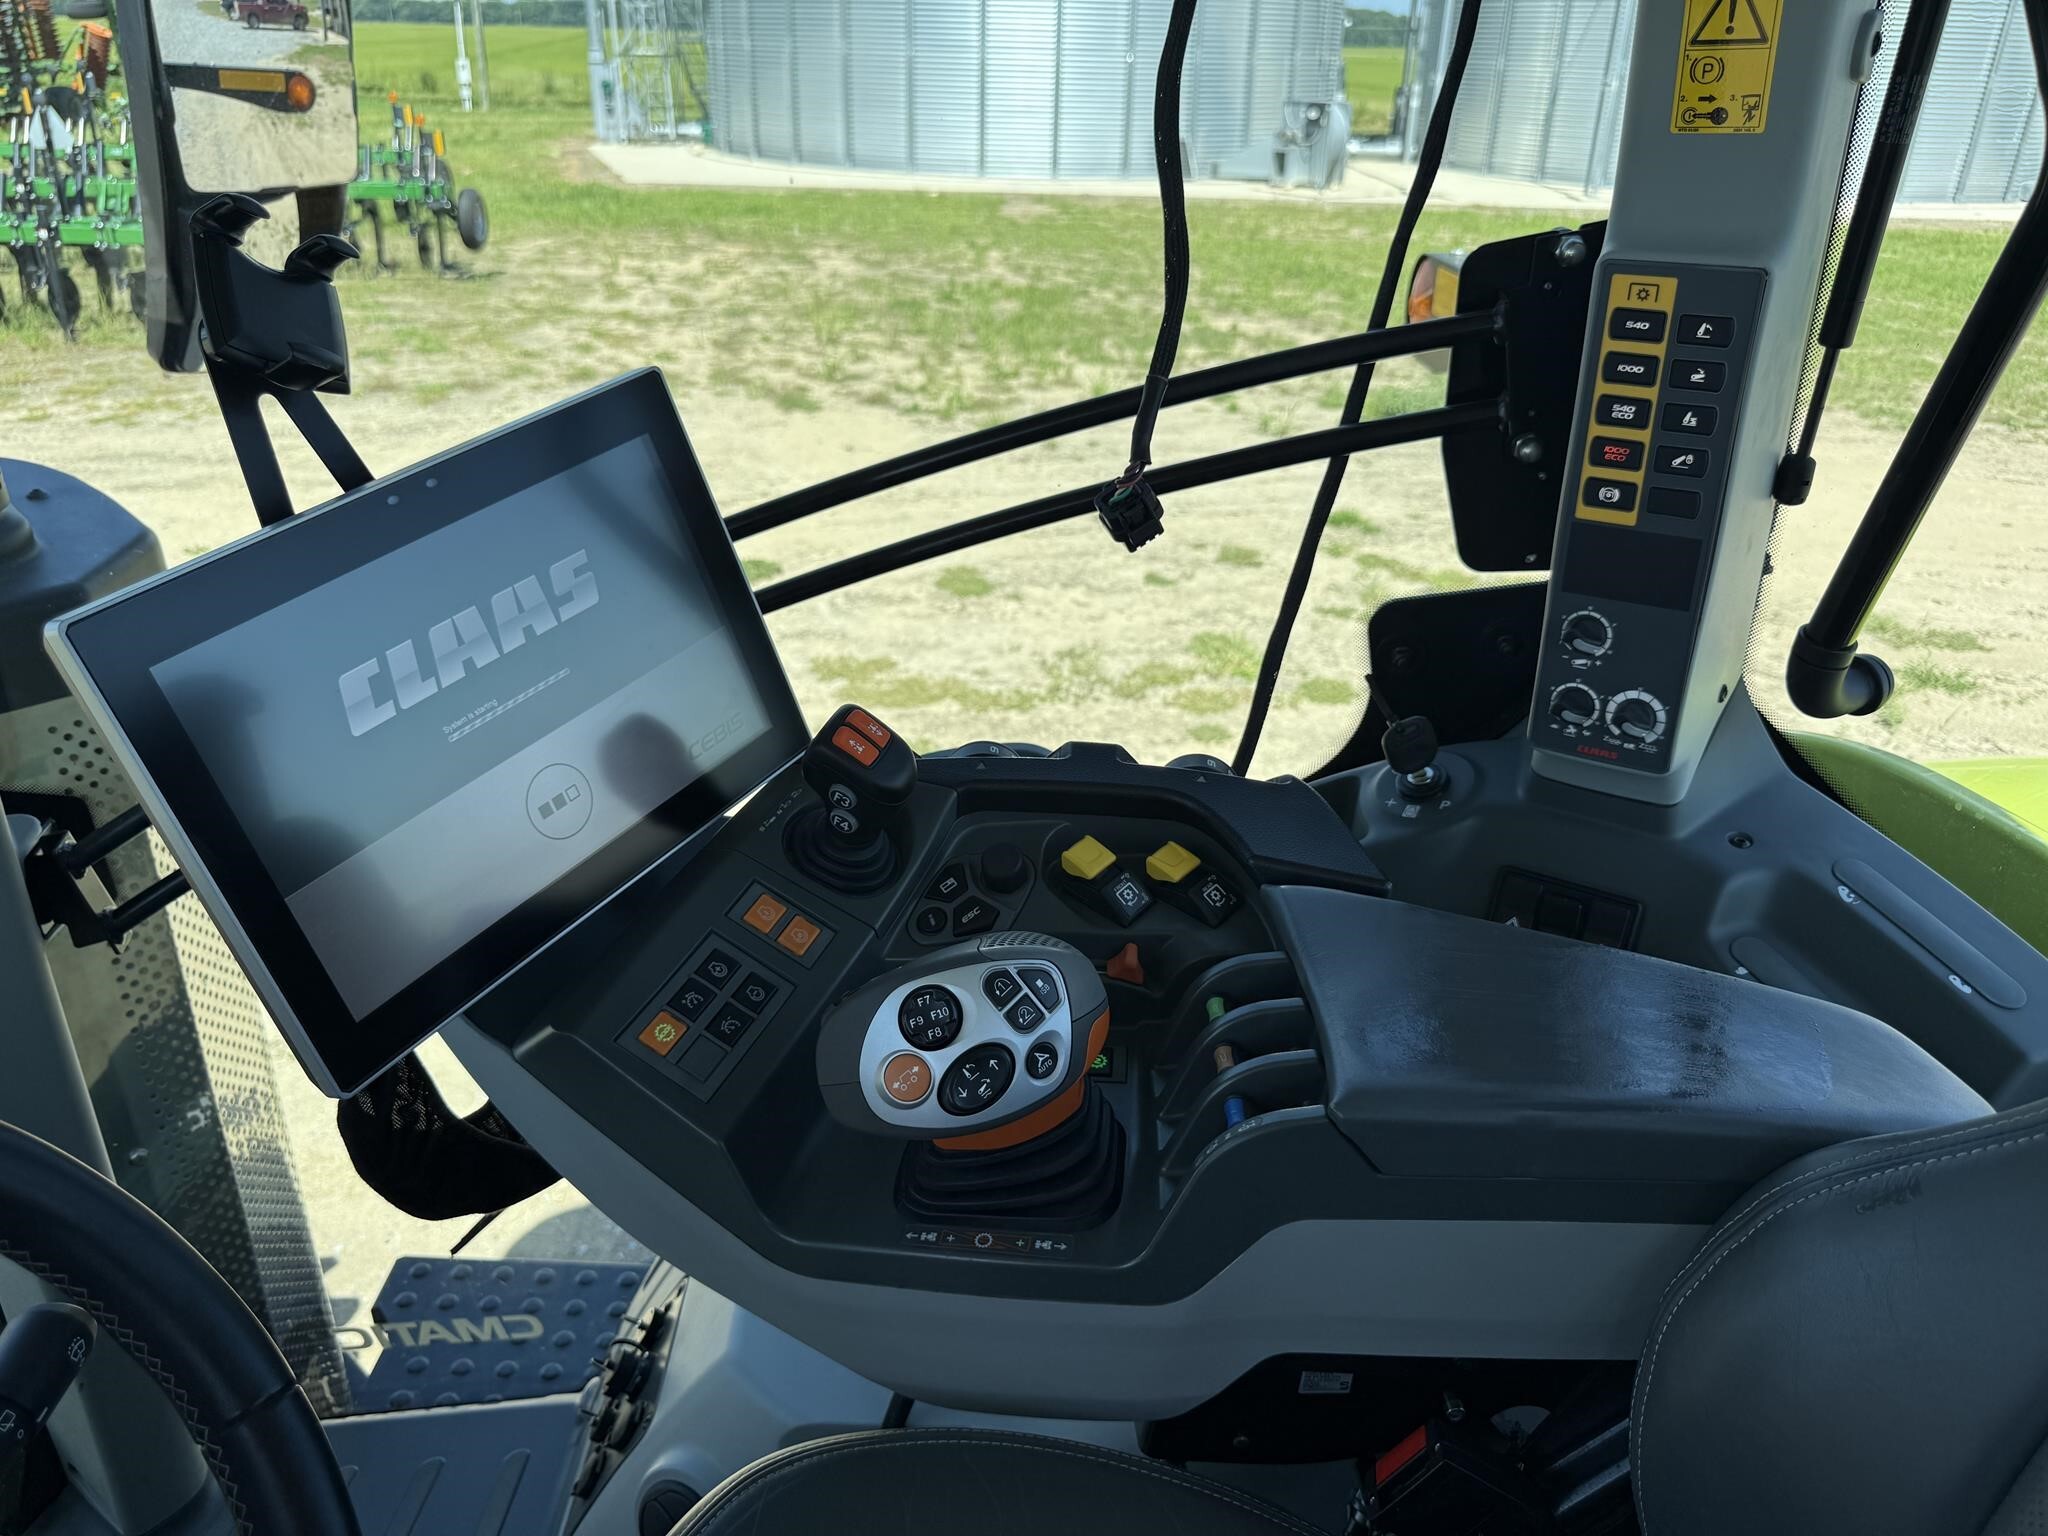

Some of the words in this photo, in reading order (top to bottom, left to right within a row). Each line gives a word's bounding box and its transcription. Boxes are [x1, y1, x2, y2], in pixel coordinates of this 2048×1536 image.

[1701, 63, 1713, 79] P
[1625, 321, 1650, 330] 540
[1617, 364, 1644, 373] 1000
[1611, 404, 1636, 412] 540
[1611, 412, 1634, 420] ECO
[1603, 446, 1630, 454] 1000
[1604, 454, 1627, 462] ECO
[338, 549, 600, 737] CLAAS
[833, 791, 850, 808] F3
[833, 816, 850, 831] F4
[961, 906, 981, 924] ESC
[917, 995, 931, 1008] F7
[930, 1006, 949, 1021] F10
[909, 1016, 924, 1029] F9
[927, 1027, 942, 1040] F8
[1038, 1059, 1053, 1074] AUTO
